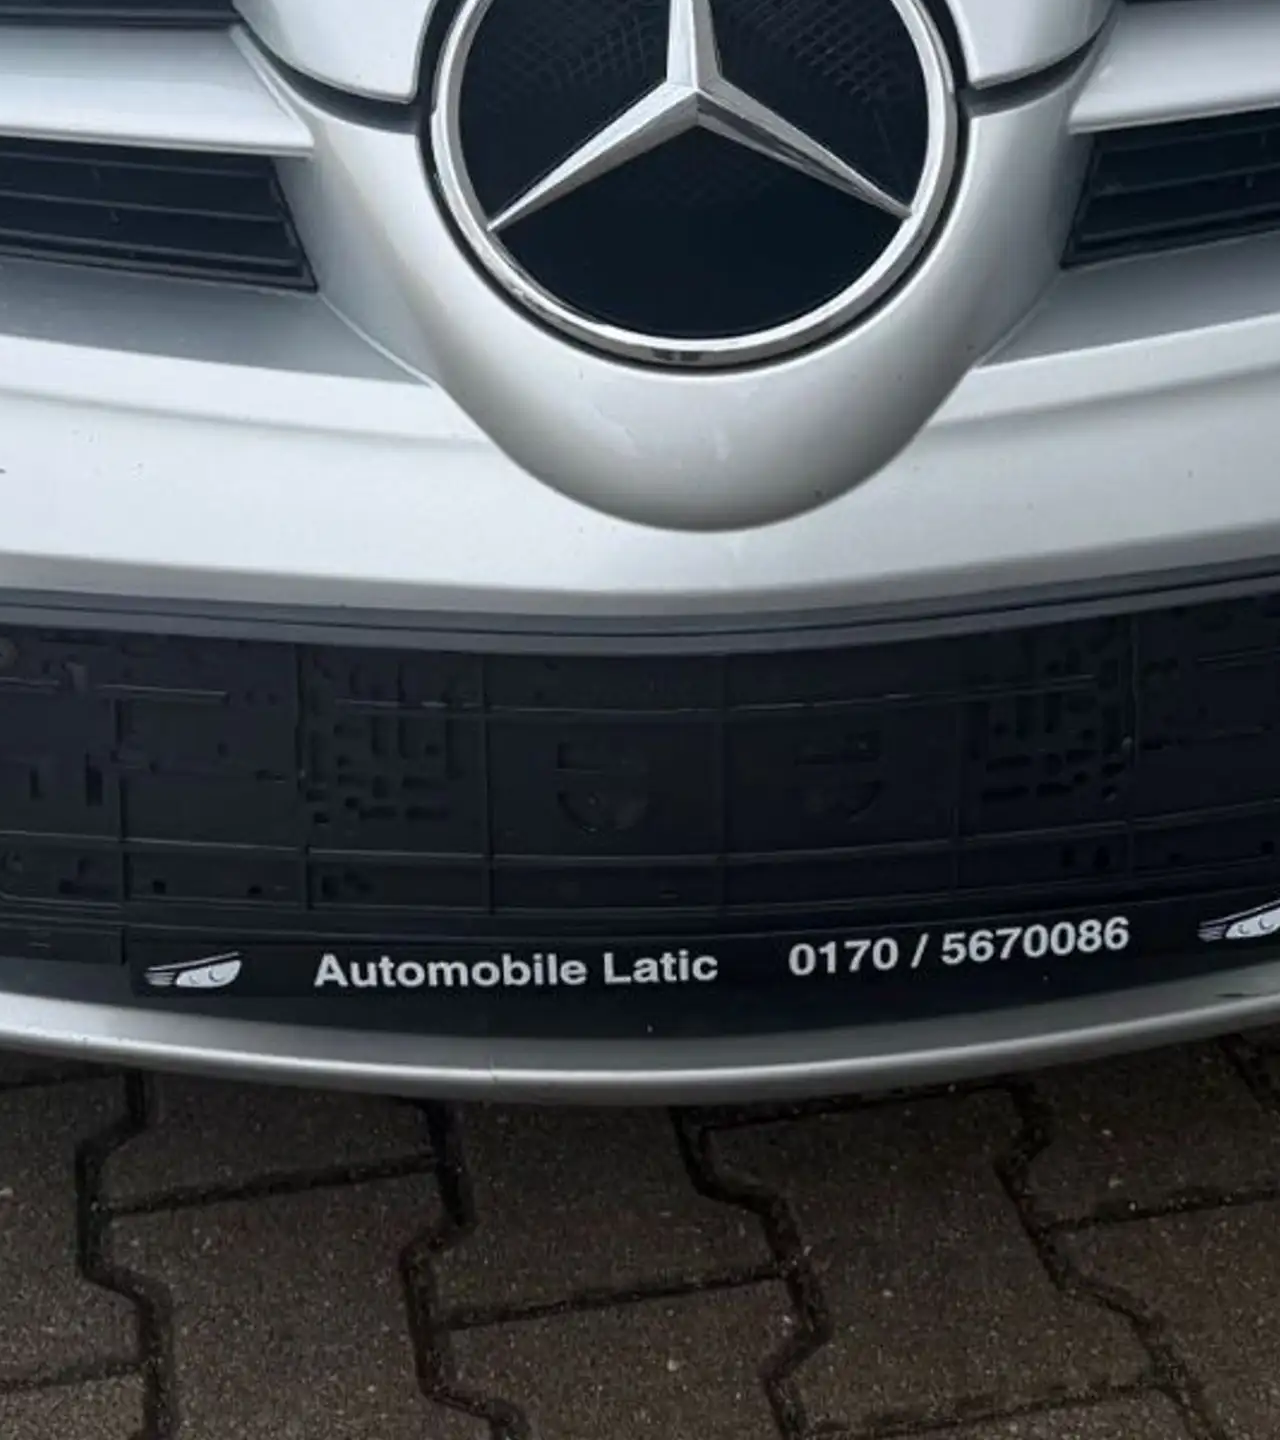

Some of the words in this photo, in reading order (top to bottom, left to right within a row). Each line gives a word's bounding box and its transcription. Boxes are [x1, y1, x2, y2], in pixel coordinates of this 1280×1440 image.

[313, 952, 587, 988] Automobile
[602, 949, 719, 985] Latic
[787, 938, 899, 976] 0170
[910, 933, 929, 969] /
[940, 916, 1130, 966] 5670086
